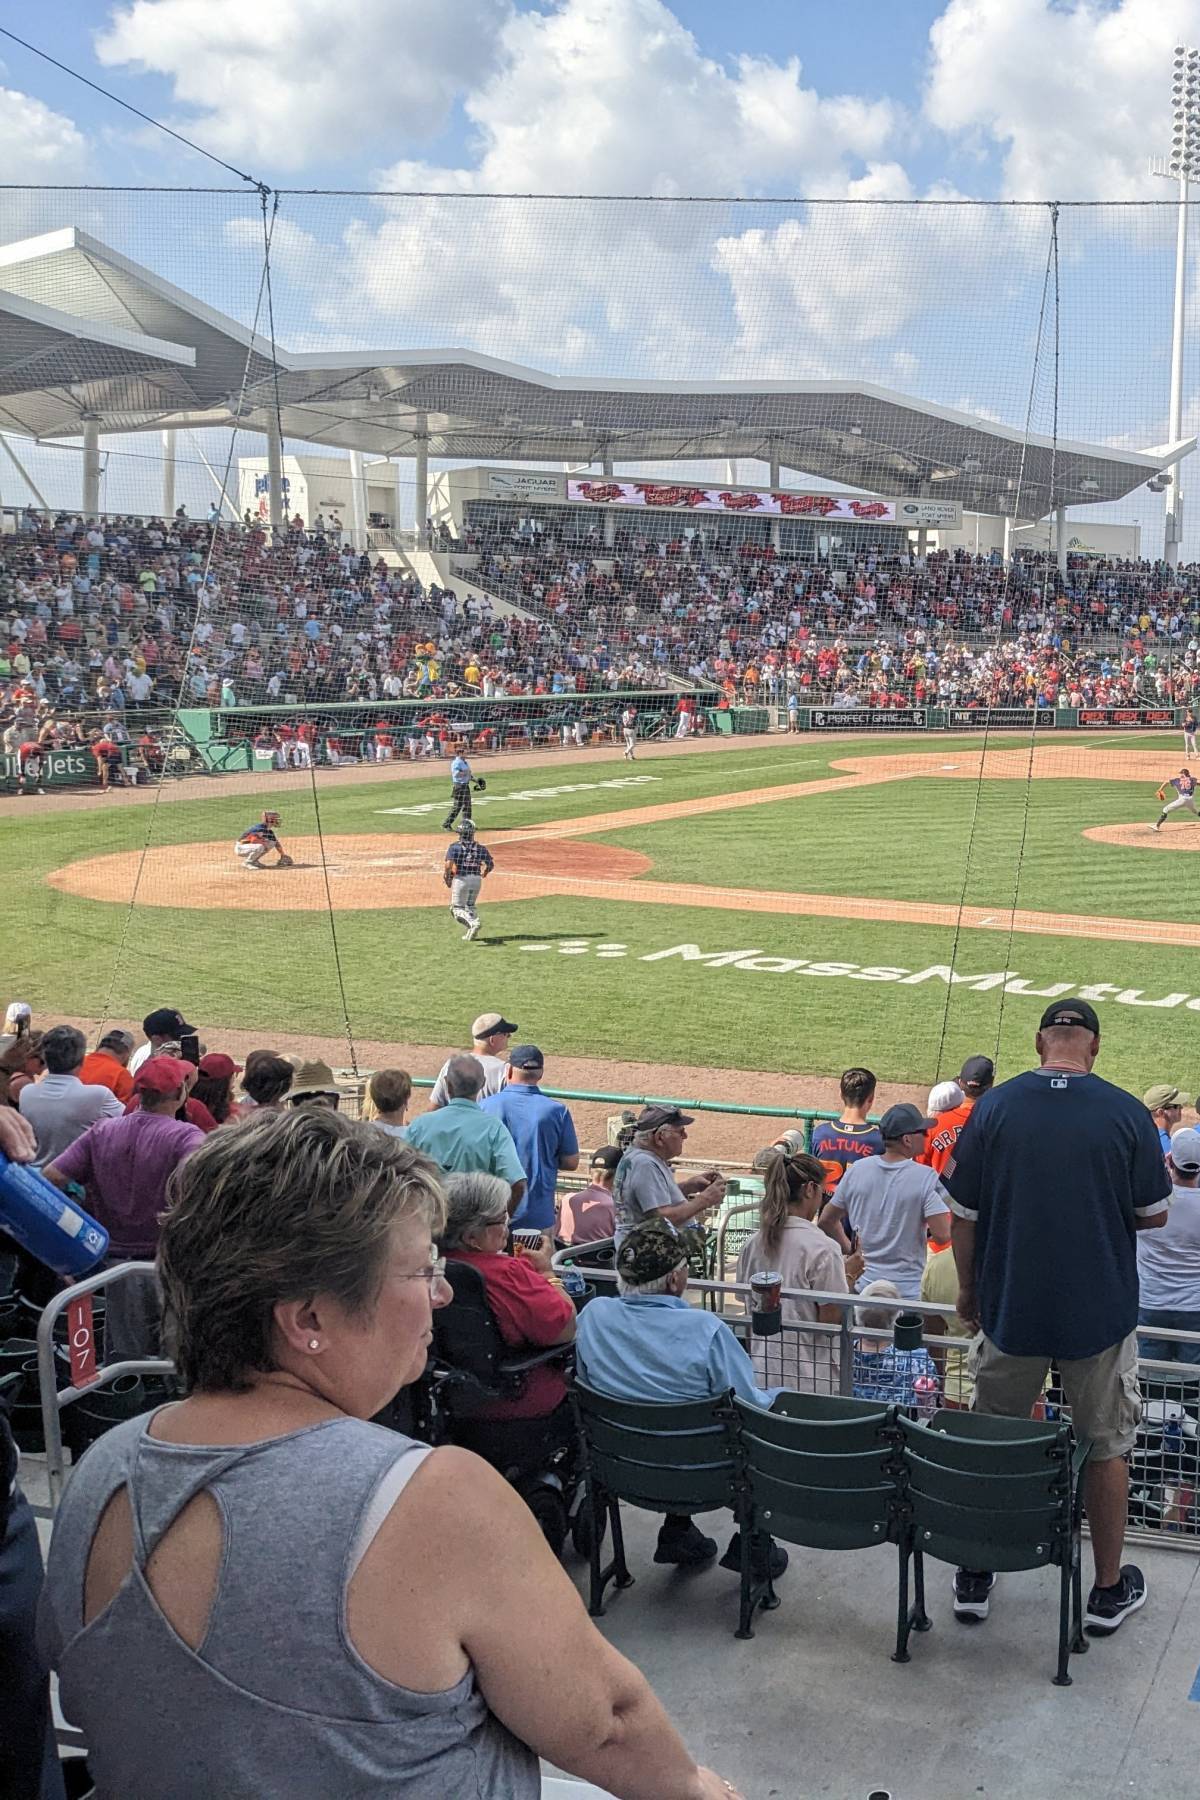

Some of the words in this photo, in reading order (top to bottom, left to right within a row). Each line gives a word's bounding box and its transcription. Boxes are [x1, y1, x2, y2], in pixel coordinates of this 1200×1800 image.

[828, 714, 870, 723] PERFECT
[819, 1137, 874, 1157] ALTUVE
[73, 1306, 90, 1370] 107
